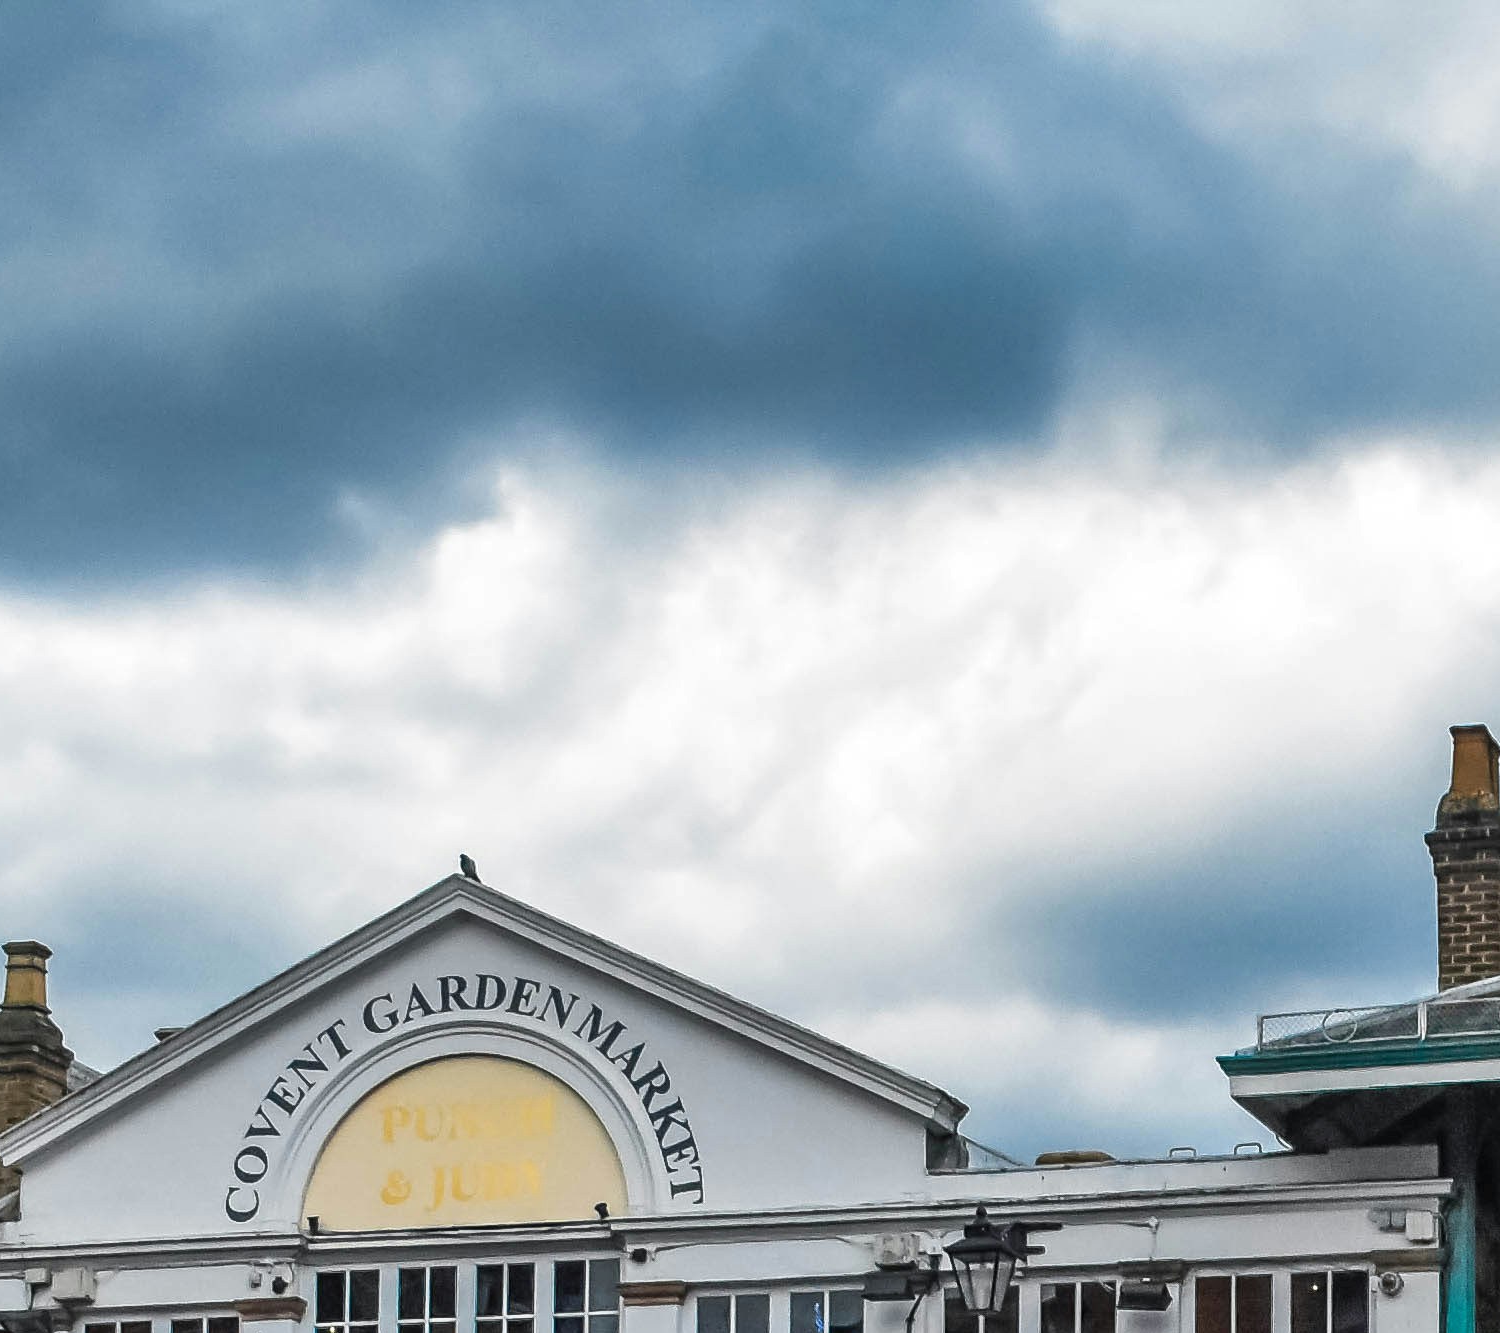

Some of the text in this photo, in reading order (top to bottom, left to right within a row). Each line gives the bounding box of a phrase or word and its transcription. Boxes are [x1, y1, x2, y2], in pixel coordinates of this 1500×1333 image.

[225, 973, 705, 1223] COVENT GARDEN MARKET
[380, 1169, 413, 1206] &
